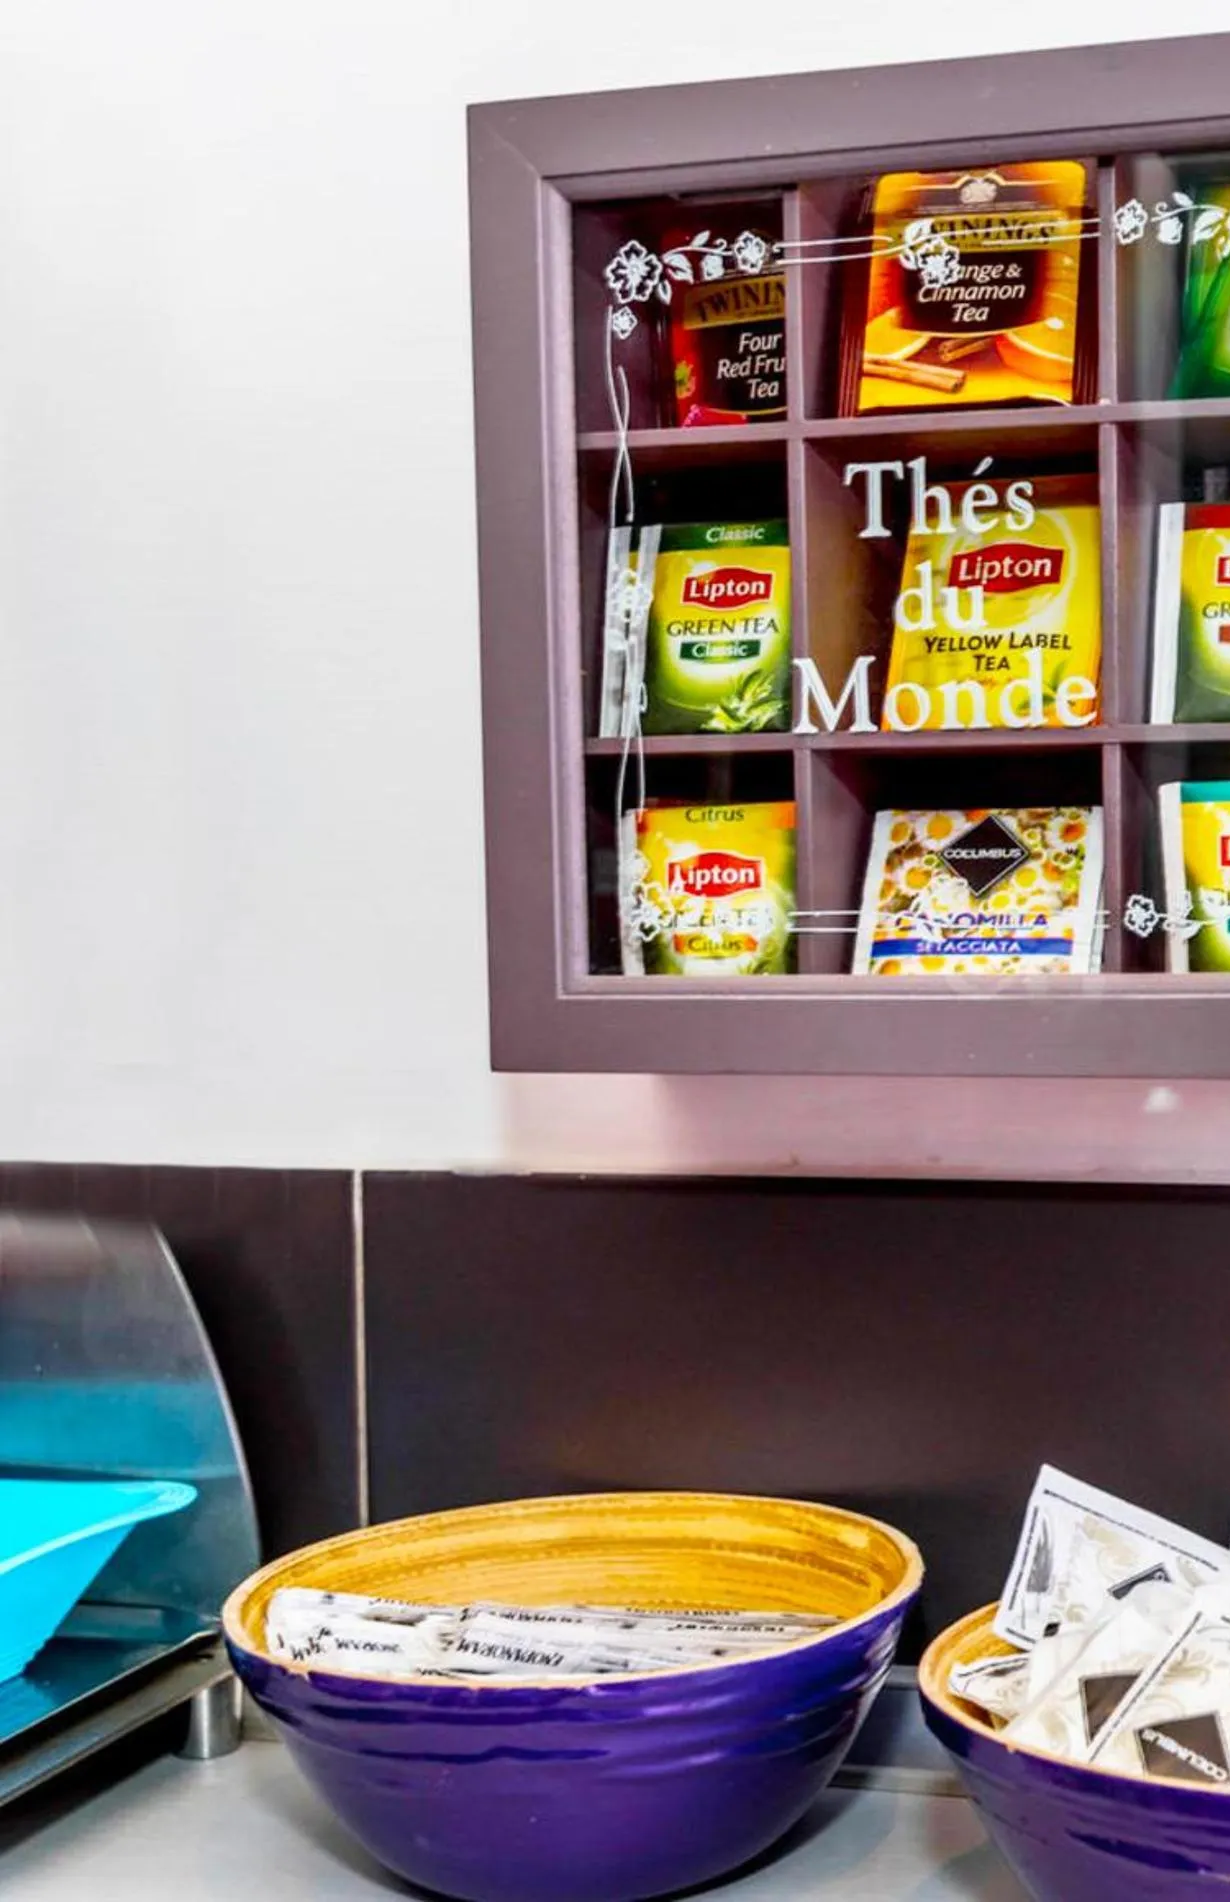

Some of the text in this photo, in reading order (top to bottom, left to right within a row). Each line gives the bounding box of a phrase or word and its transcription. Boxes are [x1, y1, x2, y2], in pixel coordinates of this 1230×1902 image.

[1005, 263, 1022, 279] &
[918, 283, 1026, 302] Cinnamon
[951, 304, 989, 322] Tea
[738, 331, 782, 354] Four
[716, 357, 751, 380] Red
[746, 378, 780, 399] Tea
[843, 456, 1036, 538] Thés
[706, 525, 765, 543] Classic
[958, 556, 1053, 585] Lipton
[689, 578, 766, 602] Lipton
[895, 560, 989, 632] du
[666, 616, 780, 637] GREEN TEA
[692, 640, 749, 658] Clsic
[923, 630, 1073, 654] YELLOW LABEL
[973, 653, 1011, 673] TEA
[792, 646, 1098, 734] Monde
